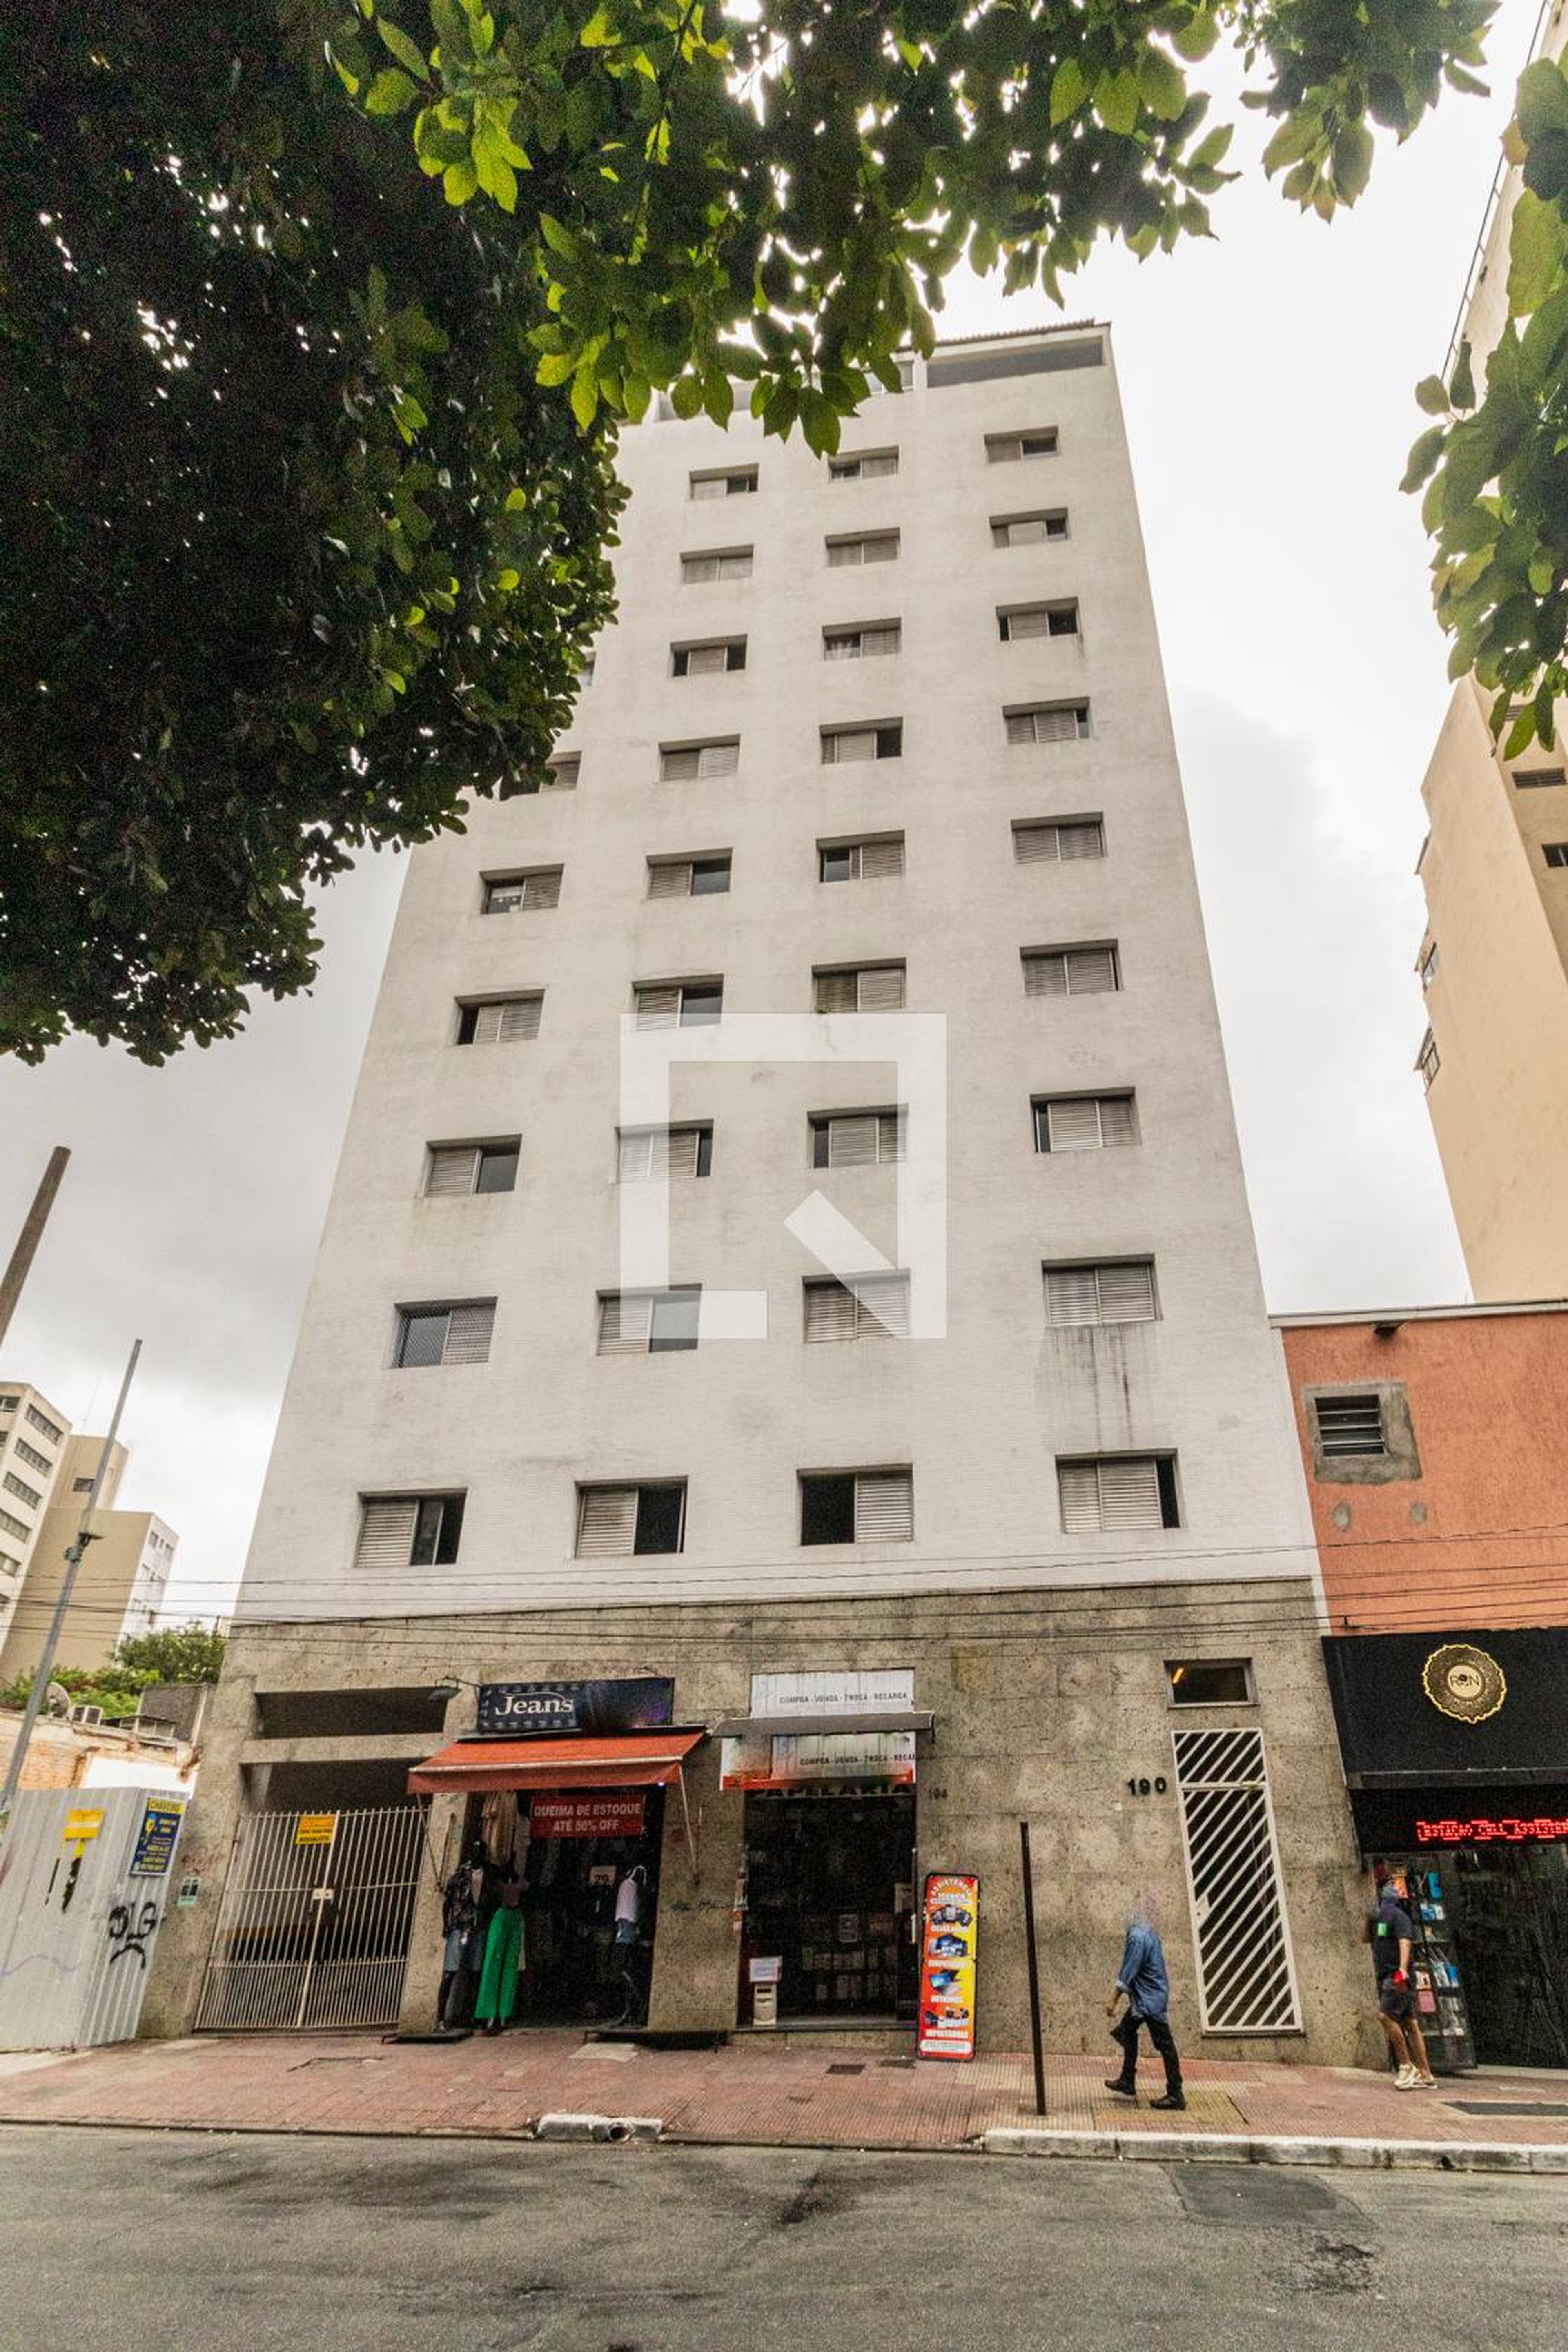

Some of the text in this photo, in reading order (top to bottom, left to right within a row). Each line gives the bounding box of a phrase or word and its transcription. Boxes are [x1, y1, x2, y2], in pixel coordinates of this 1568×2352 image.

[495, 1693, 574, 1715] Jeans
[779, 1695, 809, 1704] COMPRA
[815, 1694, 839, 1702] VENDA
[874, 1692, 908, 1700] RECARGA
[864, 1755, 888, 1763] TROCA
[1127, 1776, 1167, 1796] 190
[534, 1803, 641, 1817] QUEIMA DE ESTOQUE
[599, 1819, 619, 1830] OFF
